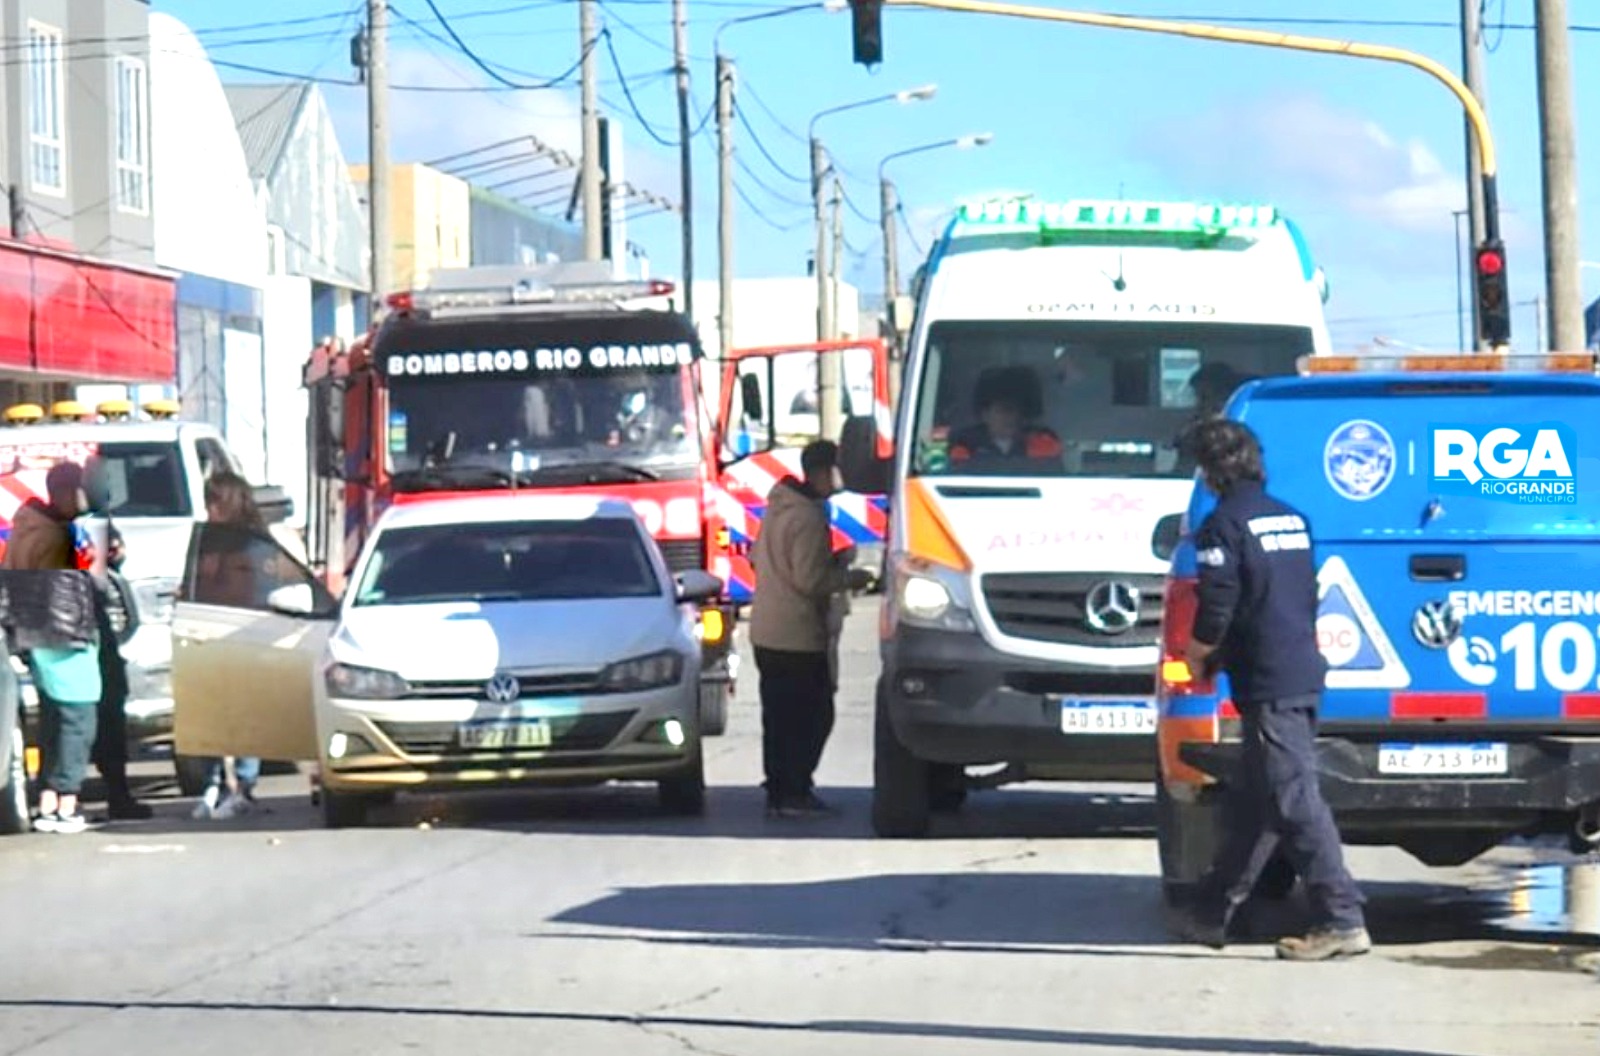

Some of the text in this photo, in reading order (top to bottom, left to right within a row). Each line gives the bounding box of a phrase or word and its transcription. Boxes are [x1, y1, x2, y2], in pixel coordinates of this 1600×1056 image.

[388, 344, 692, 376] BOMBEROS RIO GRANDE
[1501, 621, 1600, 691] 10
[1422, 752, 1462, 768] 713
[1471, 752, 1498, 767] PH
